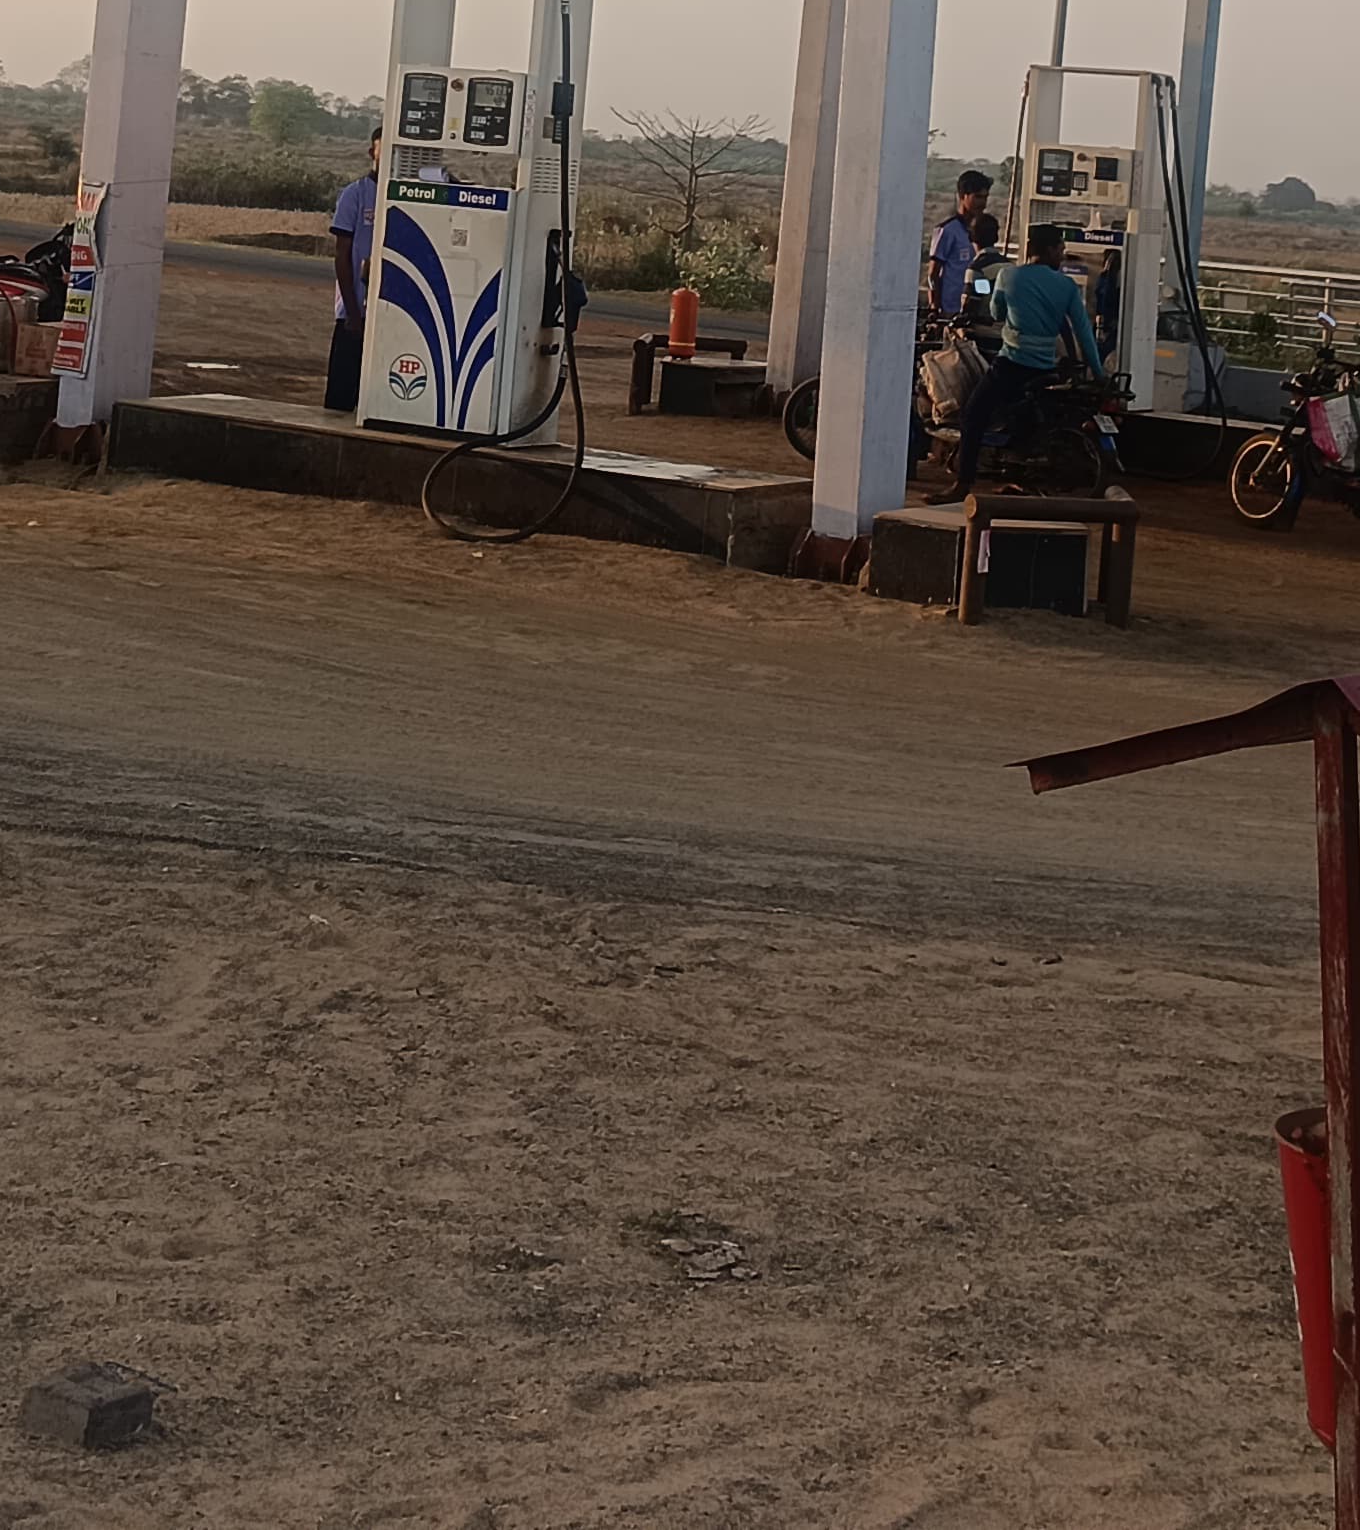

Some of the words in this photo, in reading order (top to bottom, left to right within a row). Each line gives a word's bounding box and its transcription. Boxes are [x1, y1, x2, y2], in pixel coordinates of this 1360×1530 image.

[399, 185, 436, 200] Petrol
[458, 190, 497, 206] Diesel
[1084, 231, 1114, 243] Diesel
[398, 359, 421, 375] HP
